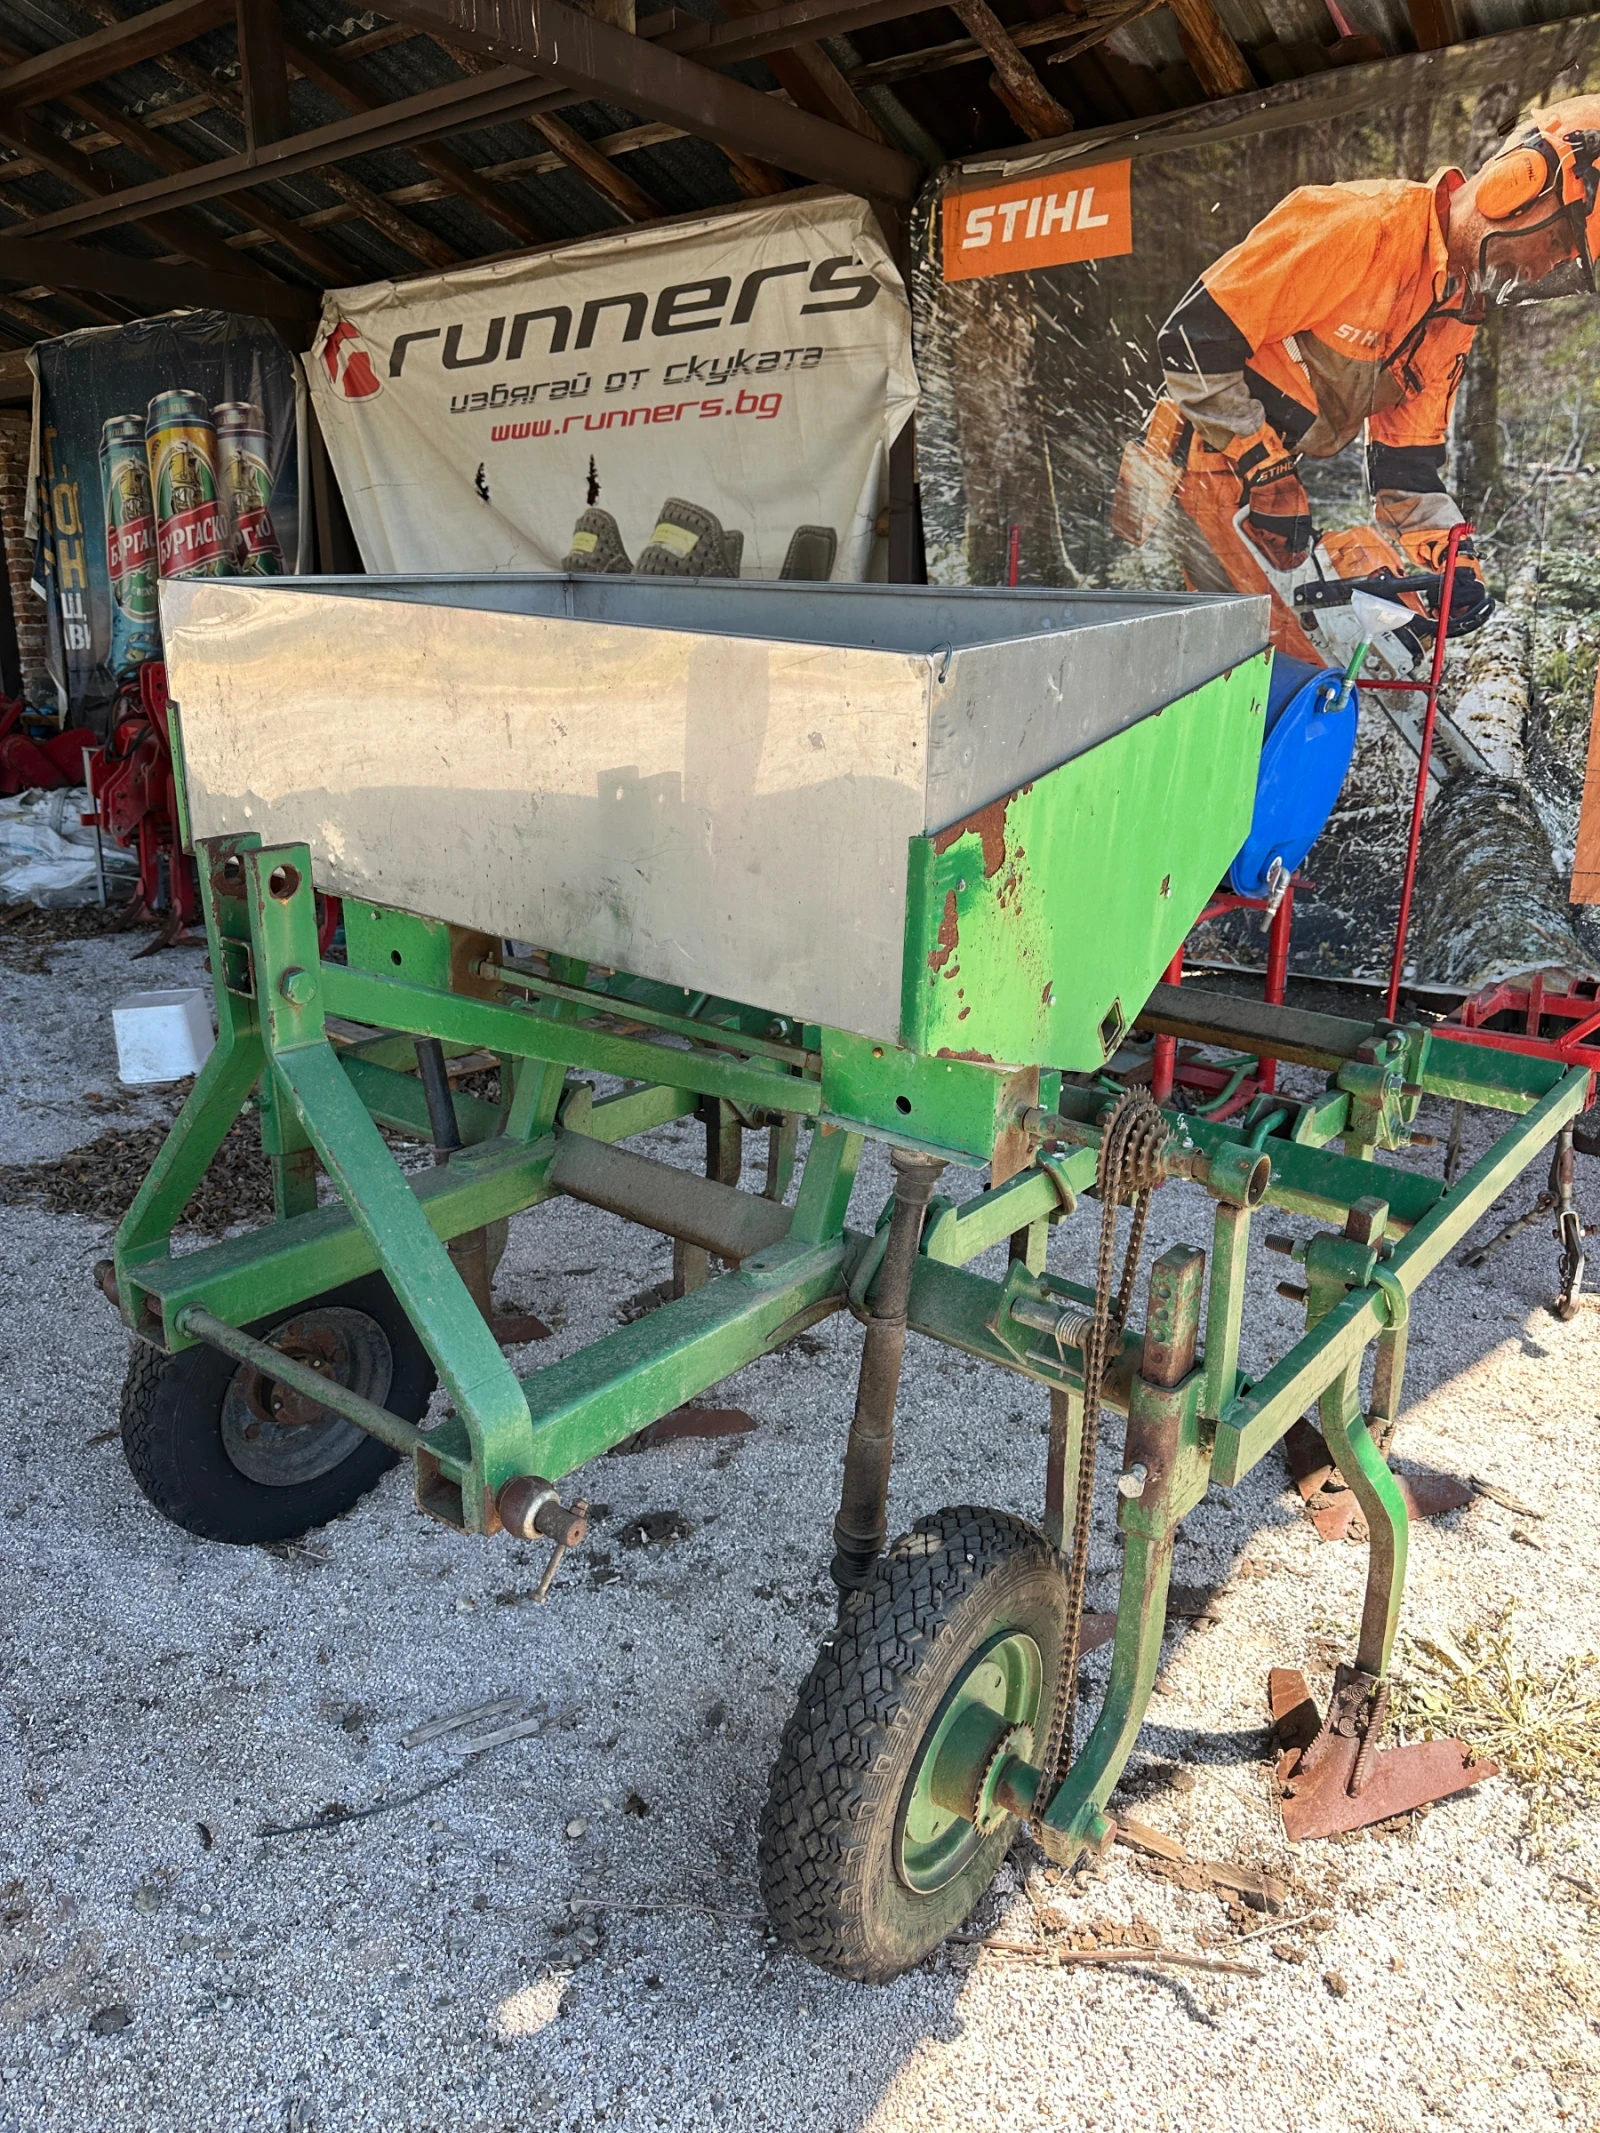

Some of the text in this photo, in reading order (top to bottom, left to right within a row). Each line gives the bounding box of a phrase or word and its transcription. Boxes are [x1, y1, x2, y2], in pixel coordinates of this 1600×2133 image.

[962, 187, 1109, 249] STIHL
[389, 256, 880, 377] runners
[450, 373, 592, 414] избягай
[663, 346, 824, 386] скуката
[491, 389, 782, 442] www.runners.bg
[1261, 461, 1293, 481] STIHL
[160, 514, 230, 566] БУРГАСКО
